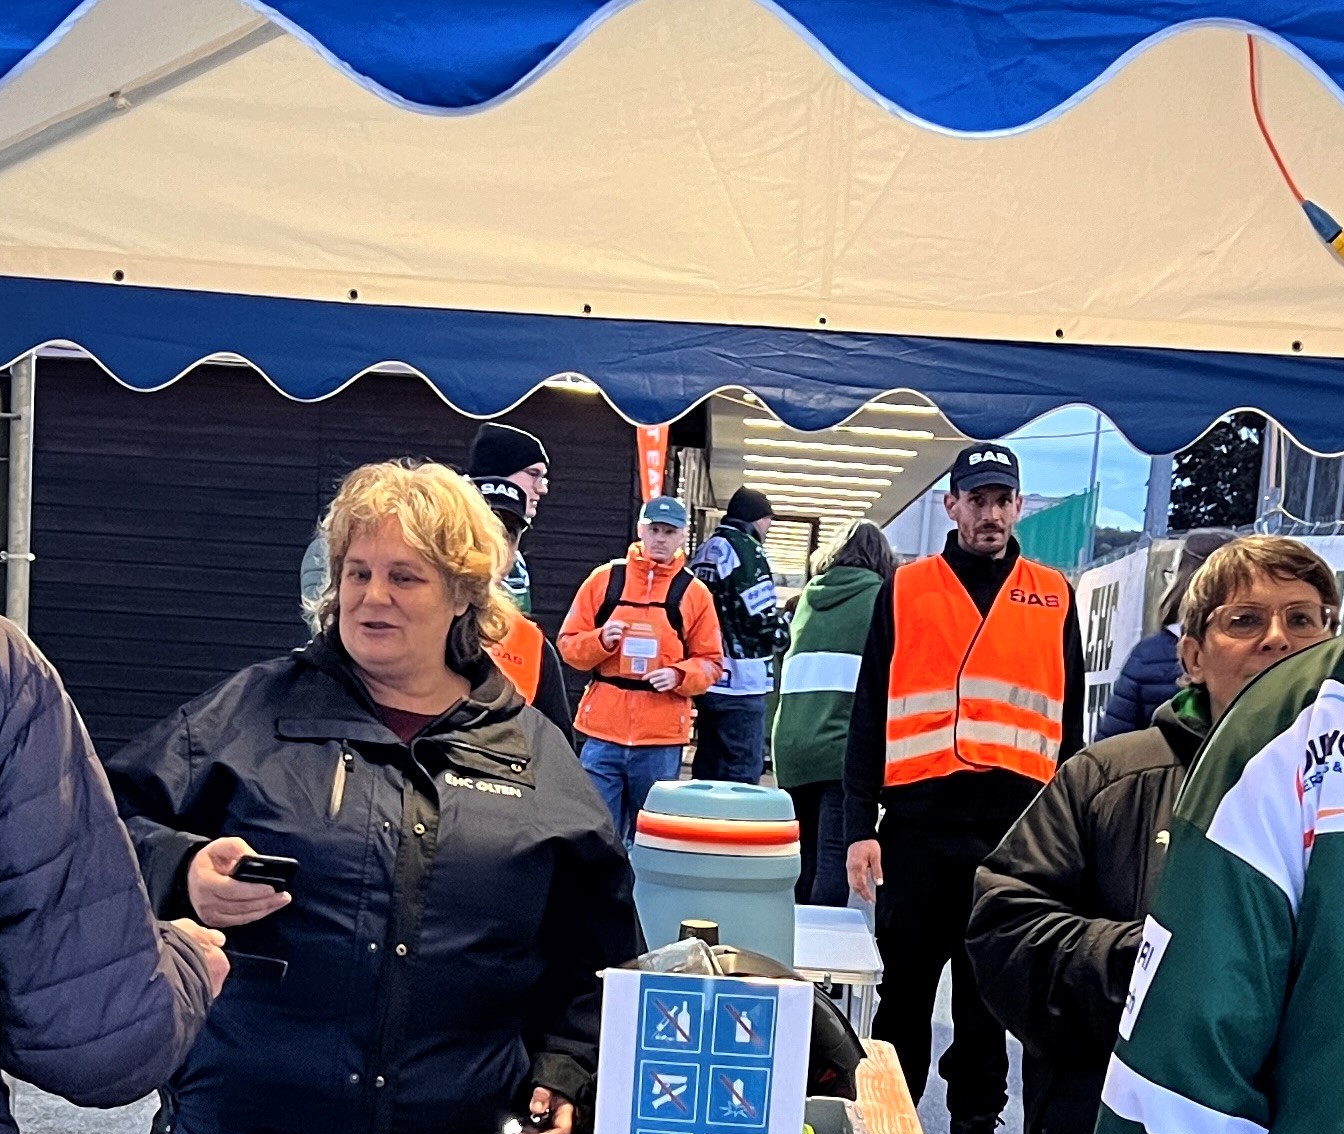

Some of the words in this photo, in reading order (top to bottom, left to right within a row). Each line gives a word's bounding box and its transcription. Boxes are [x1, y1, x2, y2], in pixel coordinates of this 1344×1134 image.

[968, 451, 1012, 466] SAS
[479, 483, 520, 501] SAS
[1010, 588, 1060, 608] SAS
[475, 780, 523, 798] OLTEN
